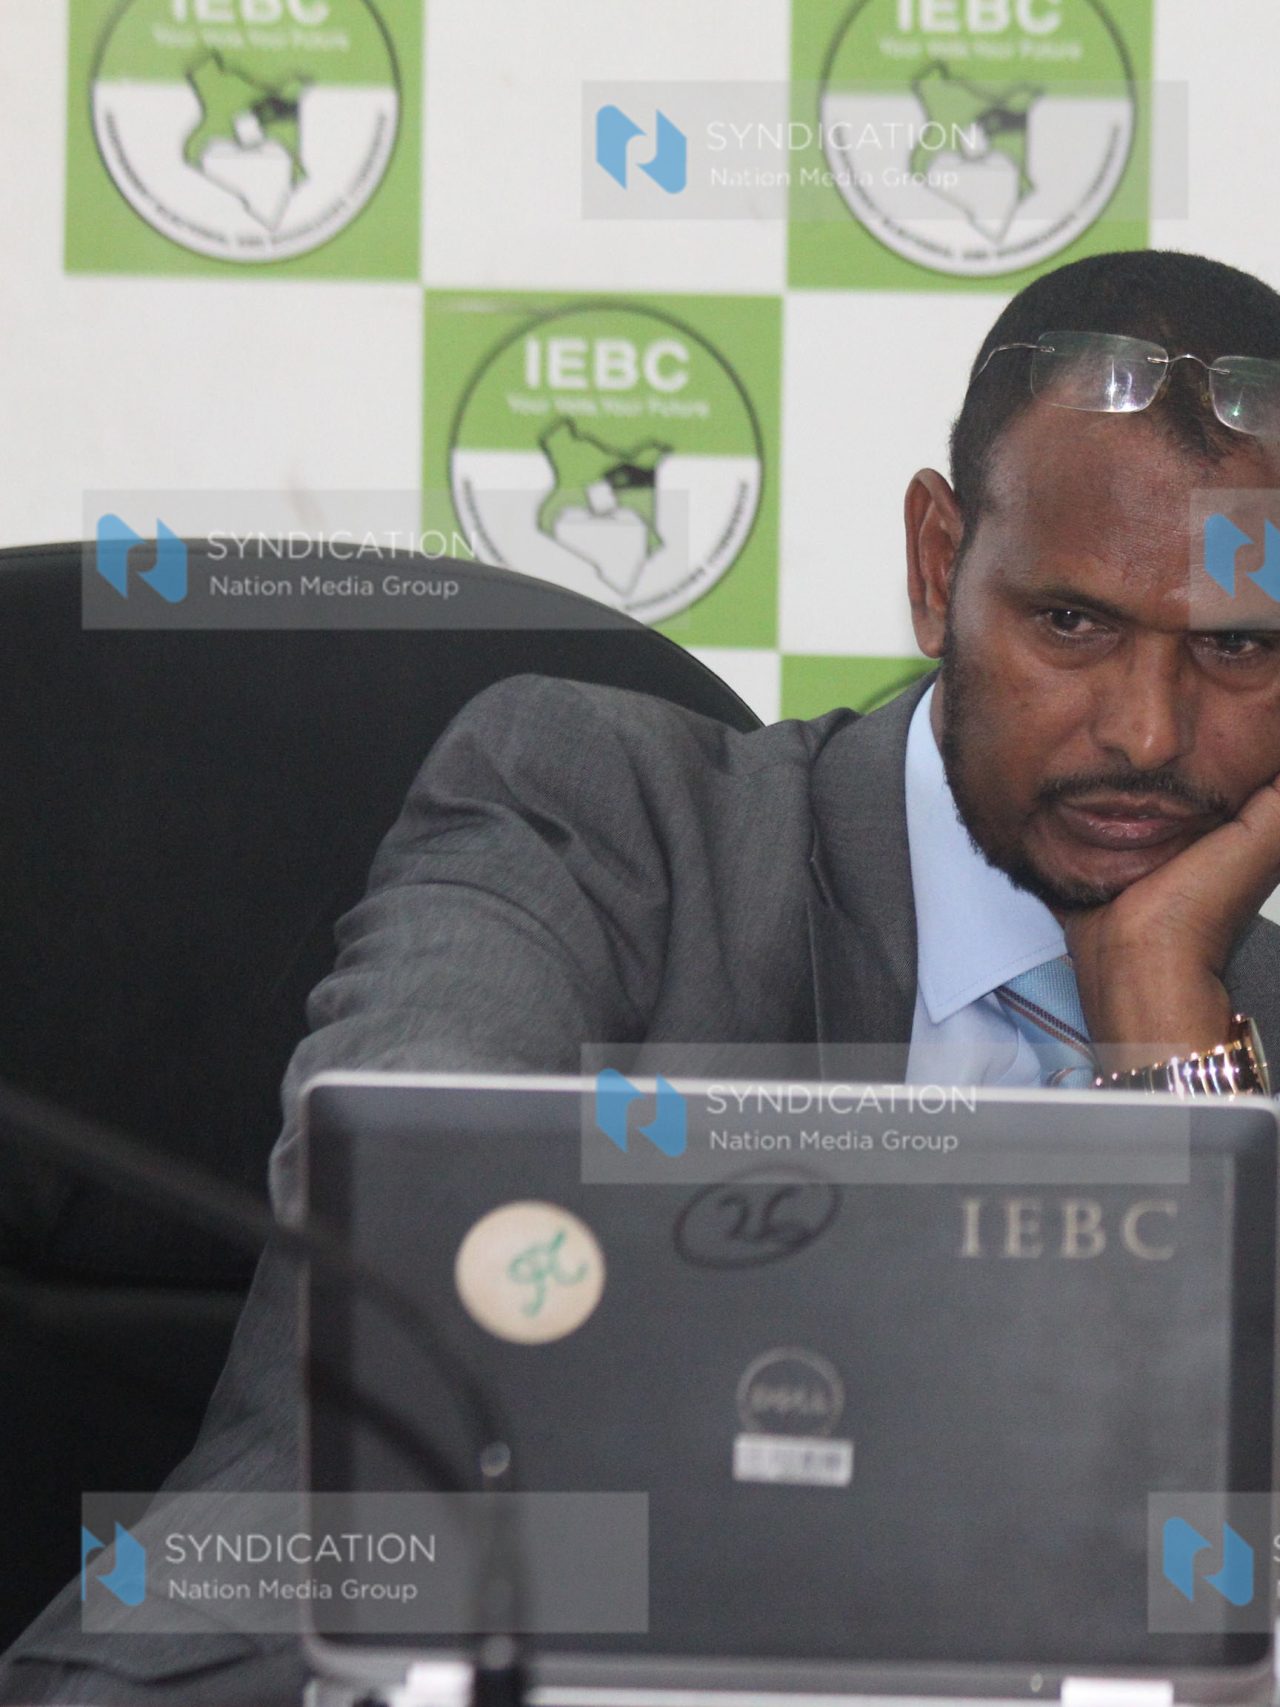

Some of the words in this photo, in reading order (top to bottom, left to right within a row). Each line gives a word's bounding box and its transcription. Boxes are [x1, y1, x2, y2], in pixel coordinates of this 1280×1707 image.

[898, 0, 1062, 34] IEBC
[525, 338, 689, 393] IEBC
[958, 1197, 1179, 1261] IEBC
